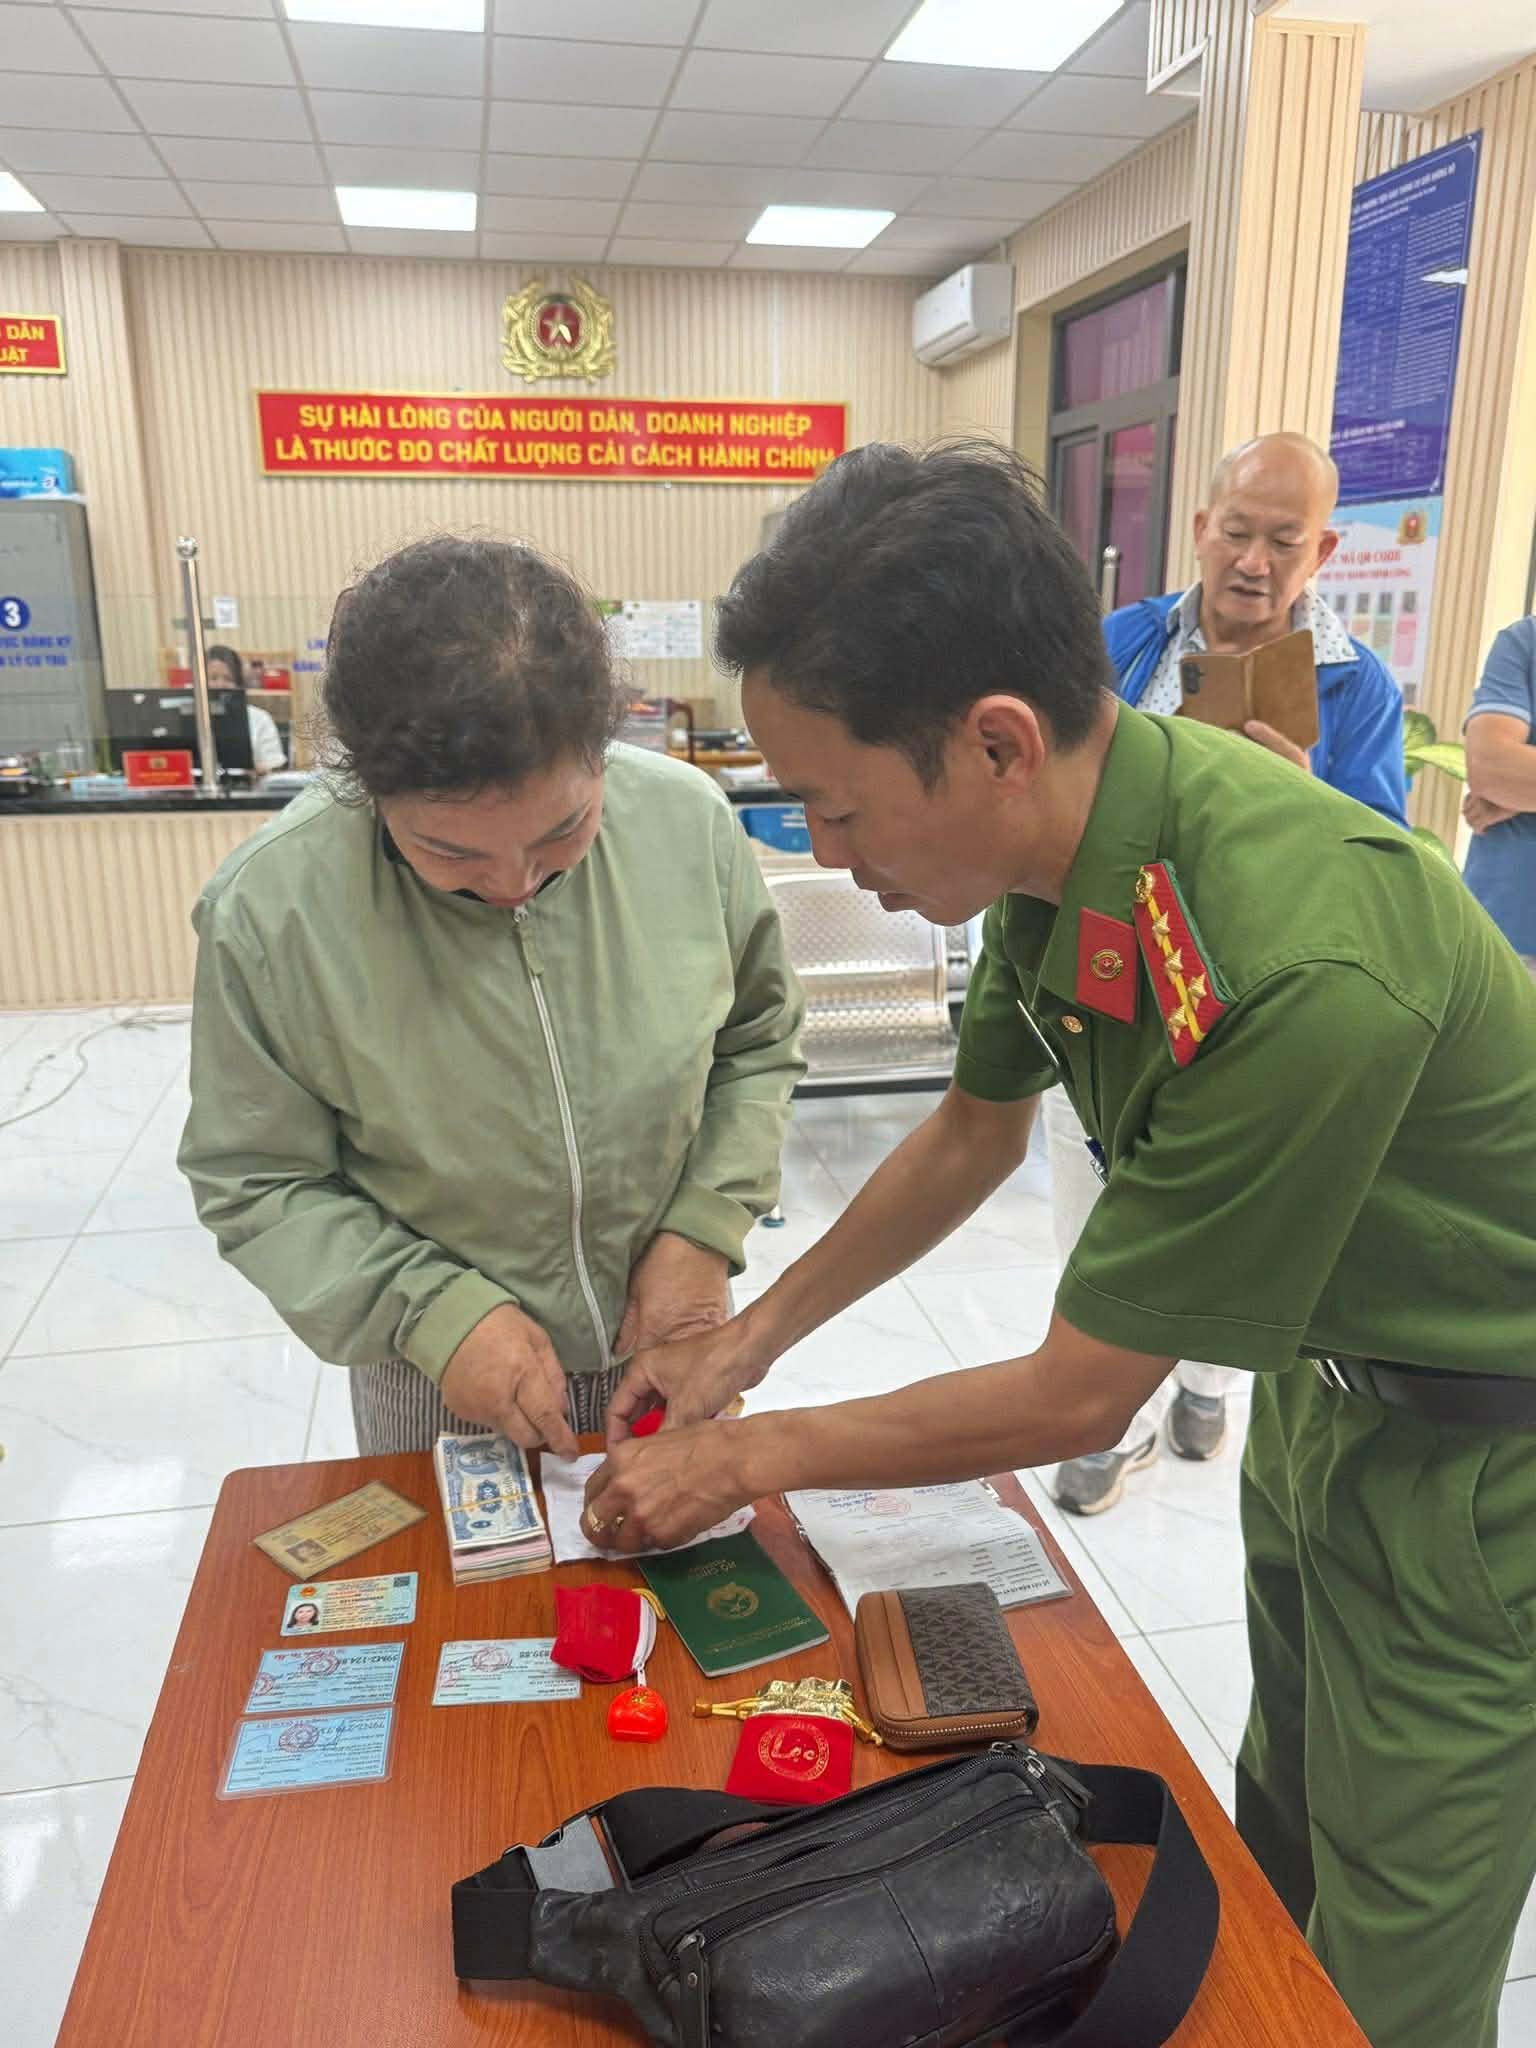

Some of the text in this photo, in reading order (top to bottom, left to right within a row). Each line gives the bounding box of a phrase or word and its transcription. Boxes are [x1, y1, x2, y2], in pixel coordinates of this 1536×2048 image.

[6, 321, 45, 341] DÂN
[299, 402, 812, 440] SỰ HÀI LÒNG CỦA NGƯỜI DÂN, DOANH NGHIỆP
[275, 434, 836, 469] LÀ THƯỚC ĐO CHẤT LƯỢNG CẢI CÁCH HÀNH CHÍNH
[4, 600, 21, 627] 3
